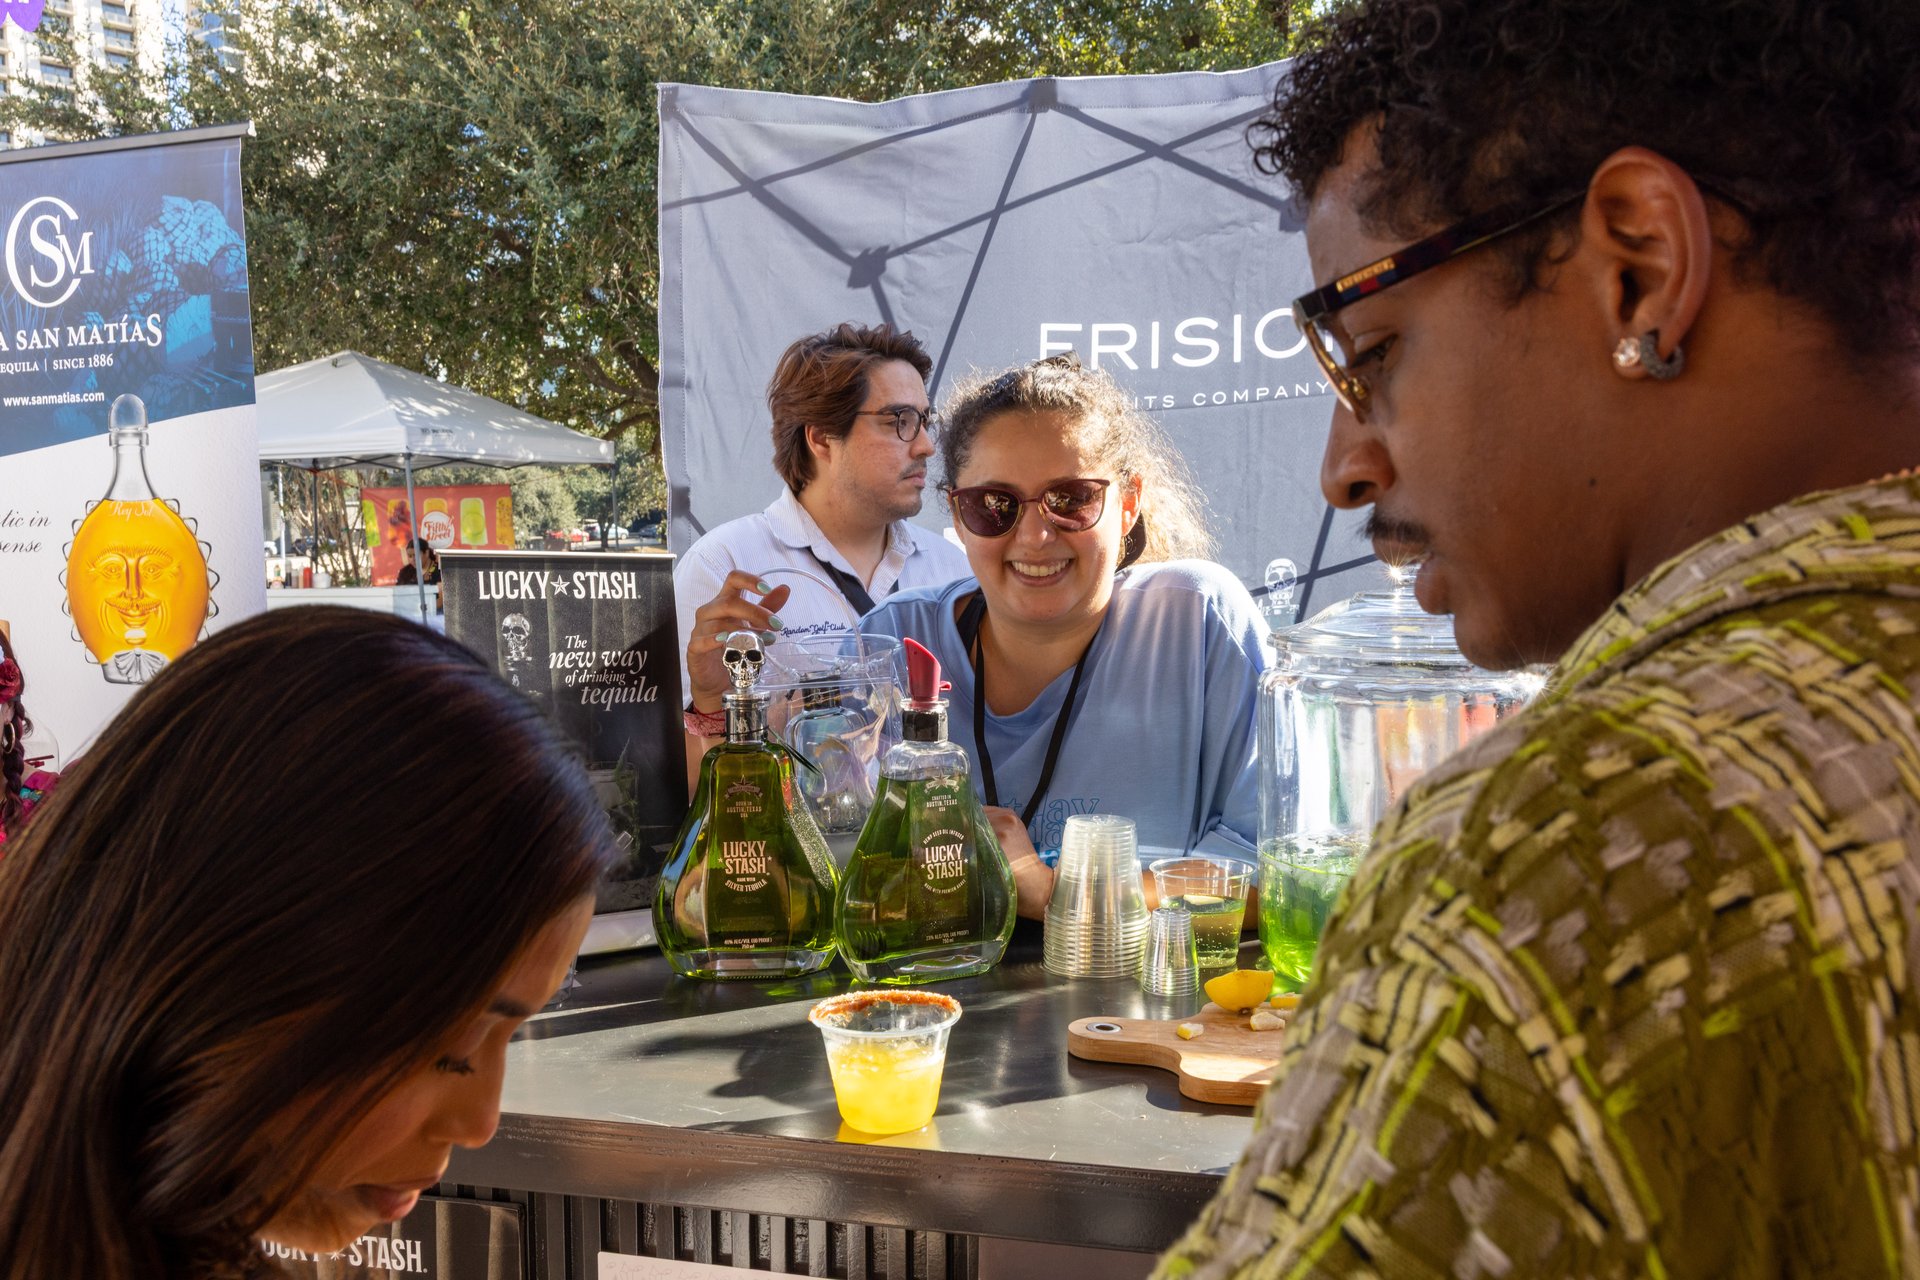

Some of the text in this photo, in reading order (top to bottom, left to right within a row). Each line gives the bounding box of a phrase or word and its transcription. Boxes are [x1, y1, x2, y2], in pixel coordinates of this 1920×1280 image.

[16, 327, 59, 350] SAN
[67, 313, 163, 347] MATÍAS
[1039, 308, 1333, 370] FRISIO
[52, 357, 85, 370] SINCE
[88, 354, 114, 368] 1886
[4, 390, 105, 407] www.sanmatias.com
[1193, 381, 1330, 407] COMPANY
[29, 510, 51, 528] in
[478, 571, 638, 600] LUCKY STASH
[780, 621, 846, 638] Random Golf Club
[565, 635, 587, 649] The
[549, 650, 648, 675] new way
[565, 670, 626, 687] of drinking
[580, 676, 658, 712] tequila
[723, 840, 767, 858] LUCKY
[925, 843, 963, 864] LUCKY
[725, 857, 766, 875] STASH
[927, 860, 963, 880] STASH
[725, 879, 768, 892] SILVER TEQUILA
[348, 1236, 423, 1273] STASH
